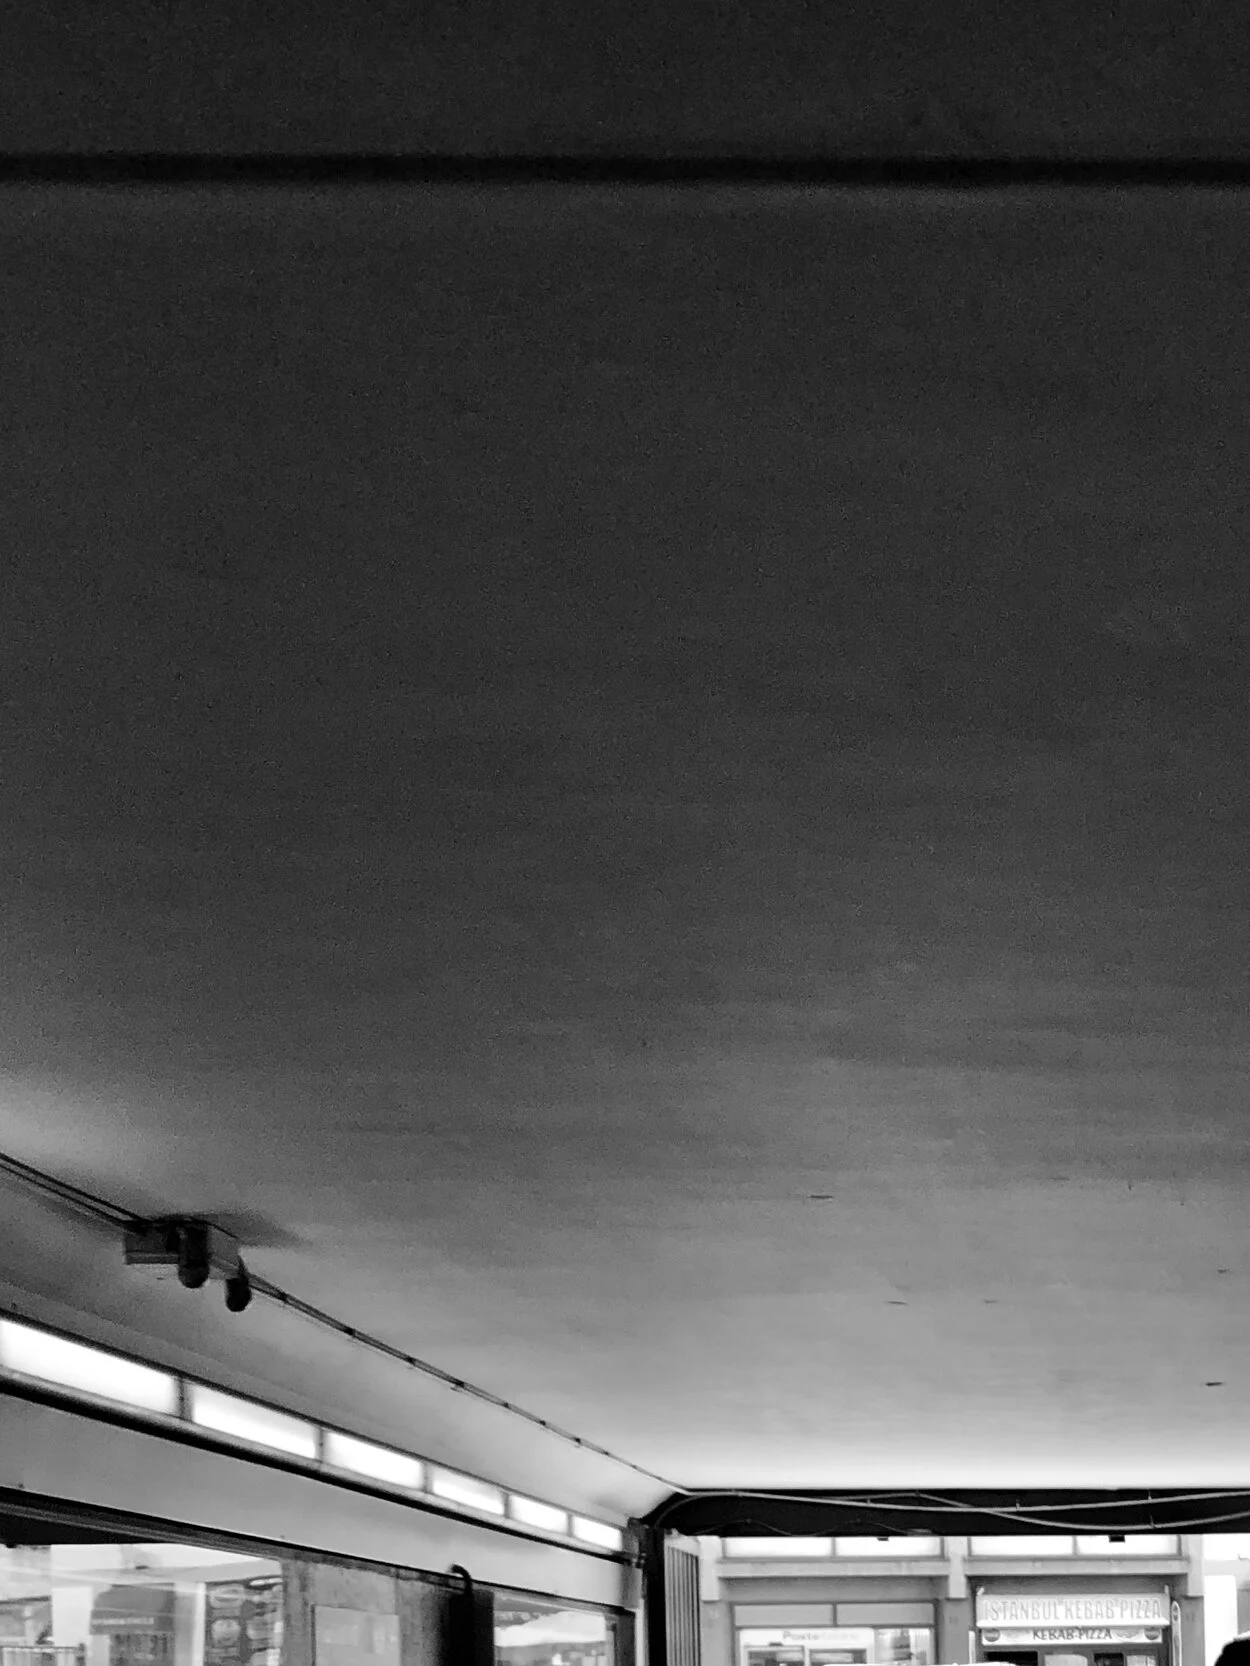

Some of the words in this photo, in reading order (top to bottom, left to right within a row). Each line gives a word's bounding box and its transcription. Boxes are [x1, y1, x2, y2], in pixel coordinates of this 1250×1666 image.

[985, 1600, 1060, 1621] ISTANBUL
[1064, 1599, 1114, 1620] KEBAB
[1120, 1598, 1162, 1619] PIZZA
